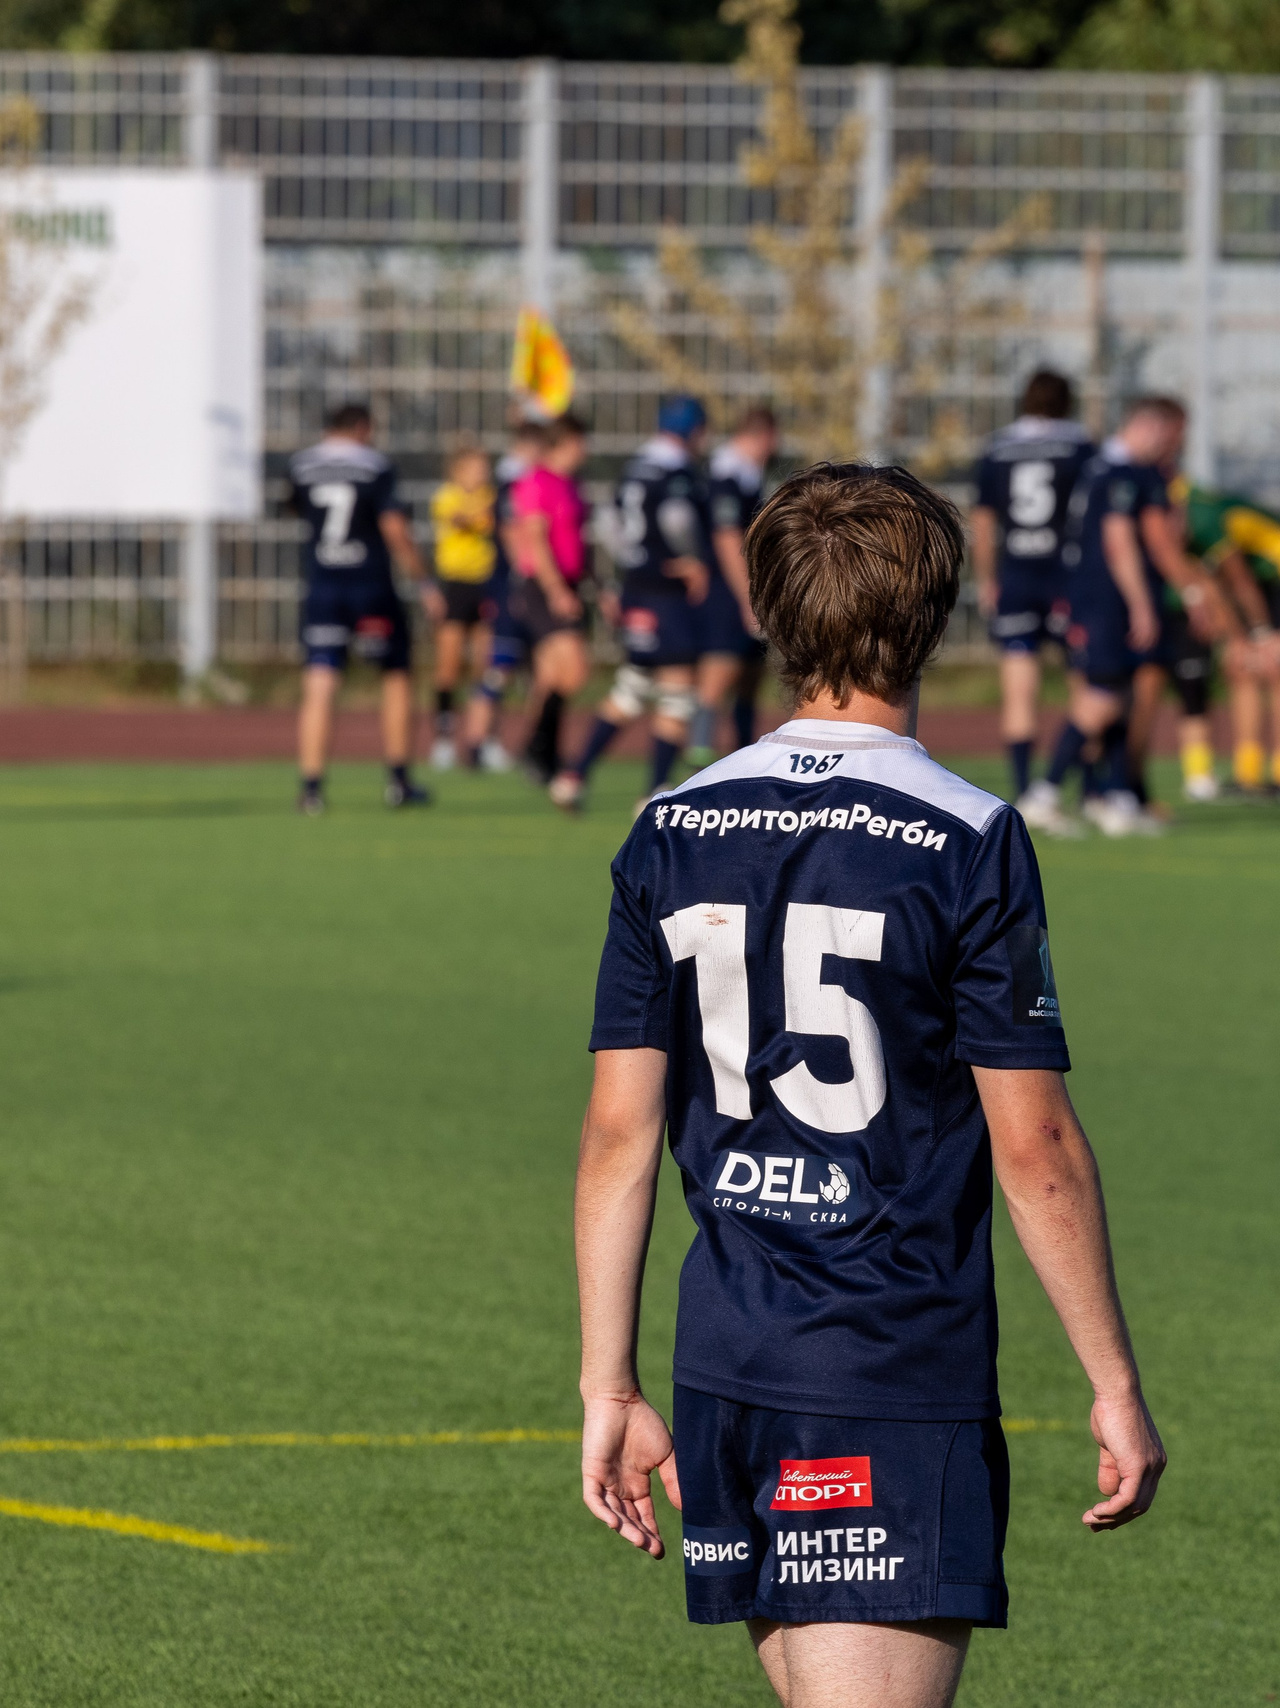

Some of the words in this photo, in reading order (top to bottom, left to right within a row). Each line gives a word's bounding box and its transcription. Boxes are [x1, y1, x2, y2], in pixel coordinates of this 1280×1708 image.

[1008, 461, 1057, 527] 5
[308, 483, 358, 546] 7
[789, 753, 844, 774] 1967
[655, 803, 948, 851] #ТерриторияРегби
[659, 902, 887, 1133] 15
[783, 1469, 853, 1482] Советский
[775, 1482, 867, 1501] СПОРТ
[777, 1527, 887, 1555] ИНТЕР
[778, 1557, 904, 1584] ЛИЗИНГ
